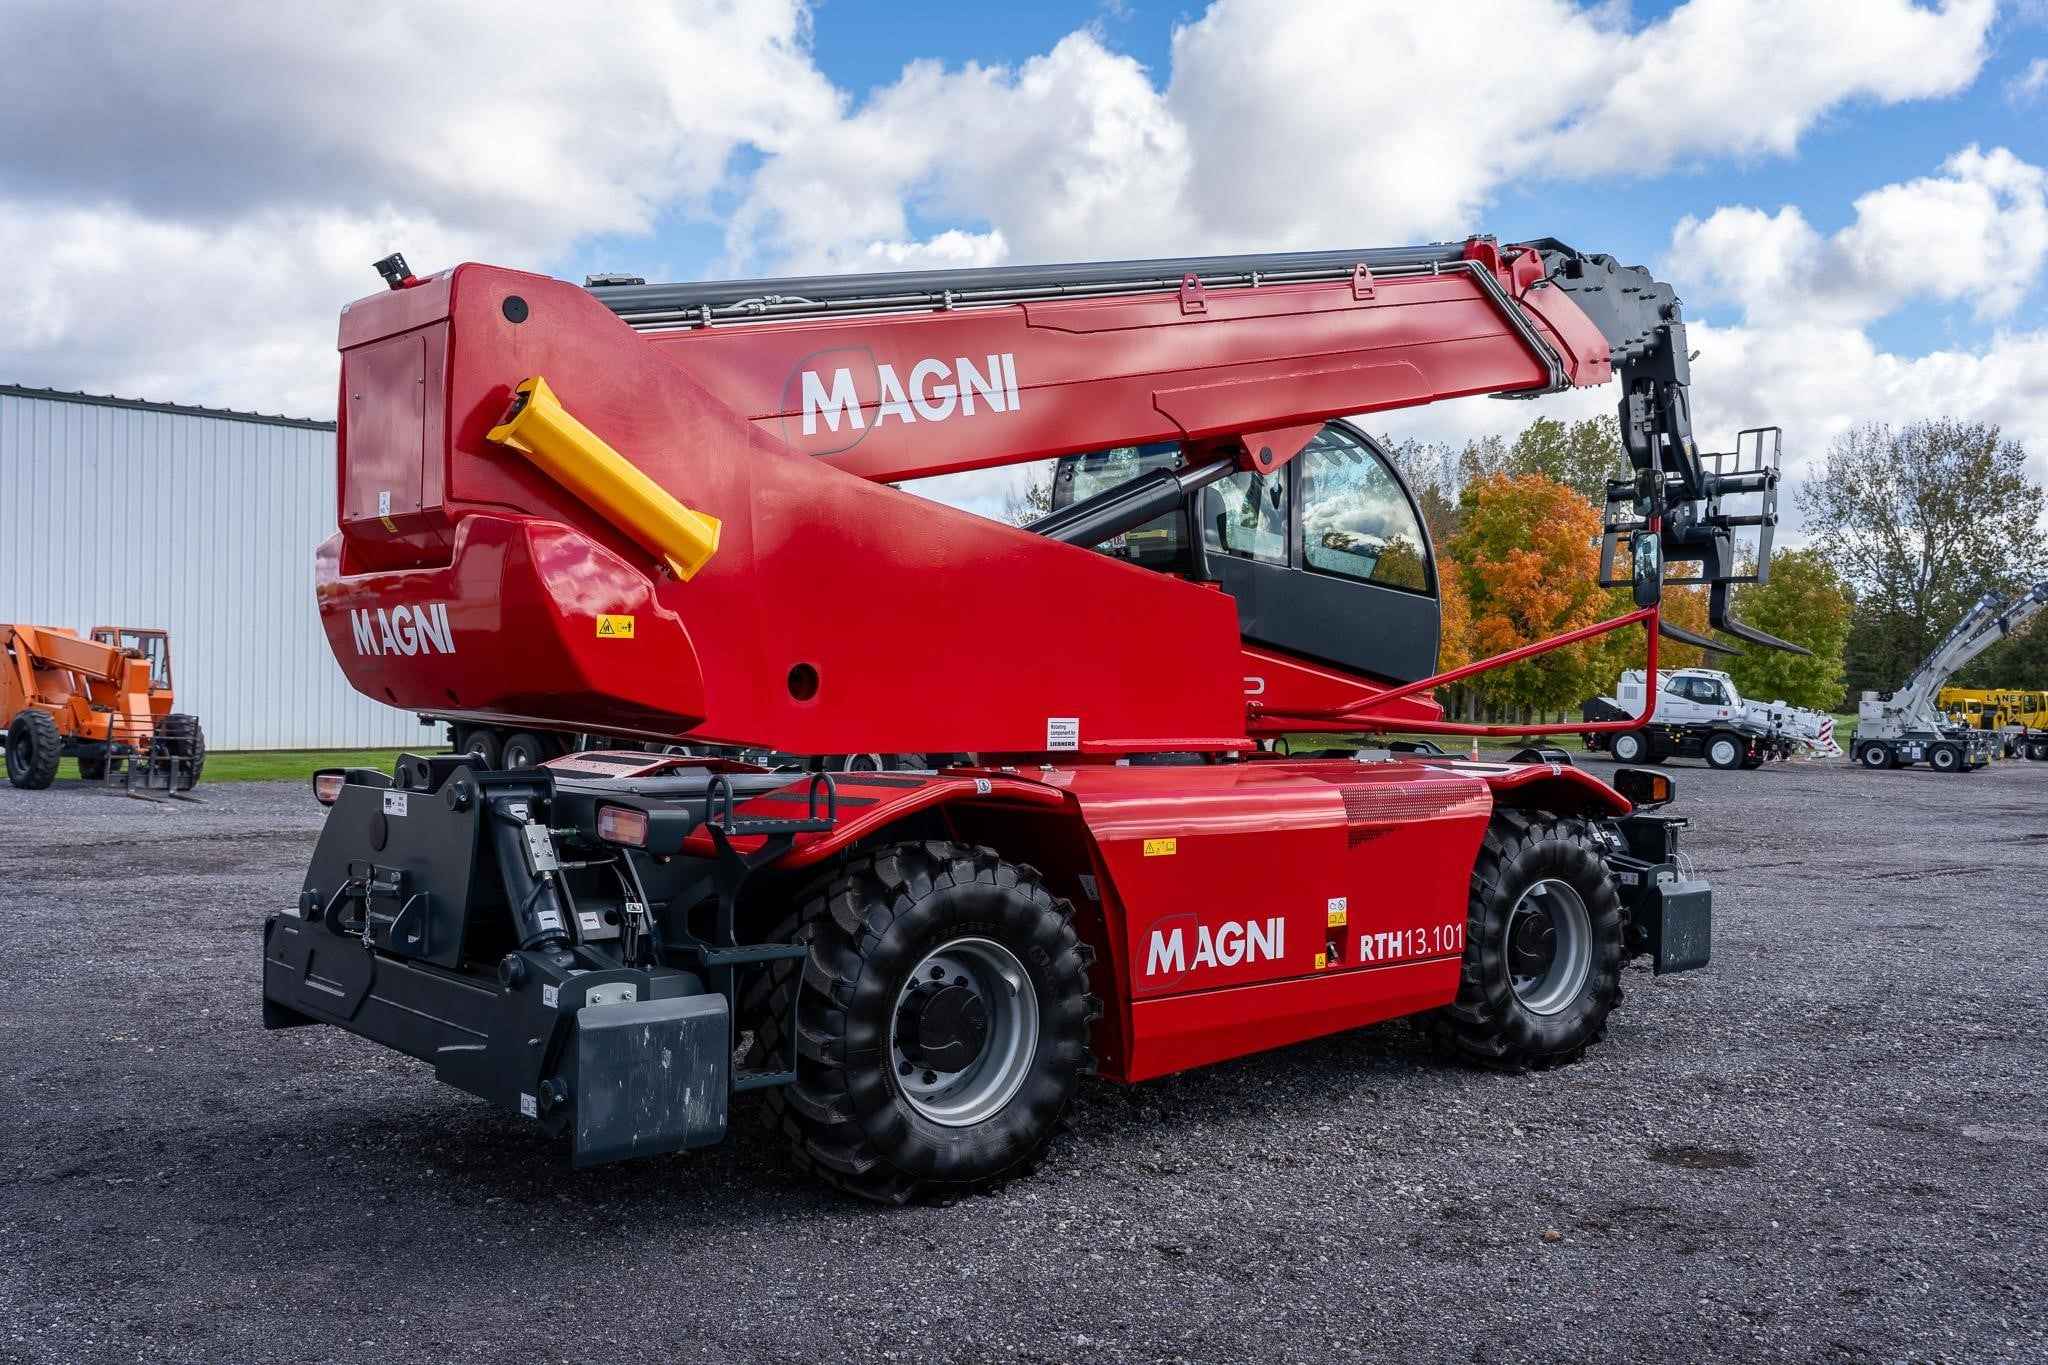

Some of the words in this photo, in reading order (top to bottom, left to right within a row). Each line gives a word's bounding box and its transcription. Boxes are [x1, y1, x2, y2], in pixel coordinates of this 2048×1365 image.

[801, 353, 1021, 436] MAGNI
[350, 603, 456, 656] MAGNI
[1986, 694, 2022, 702] LANE
[1146, 917, 1285, 976] MAGNI
